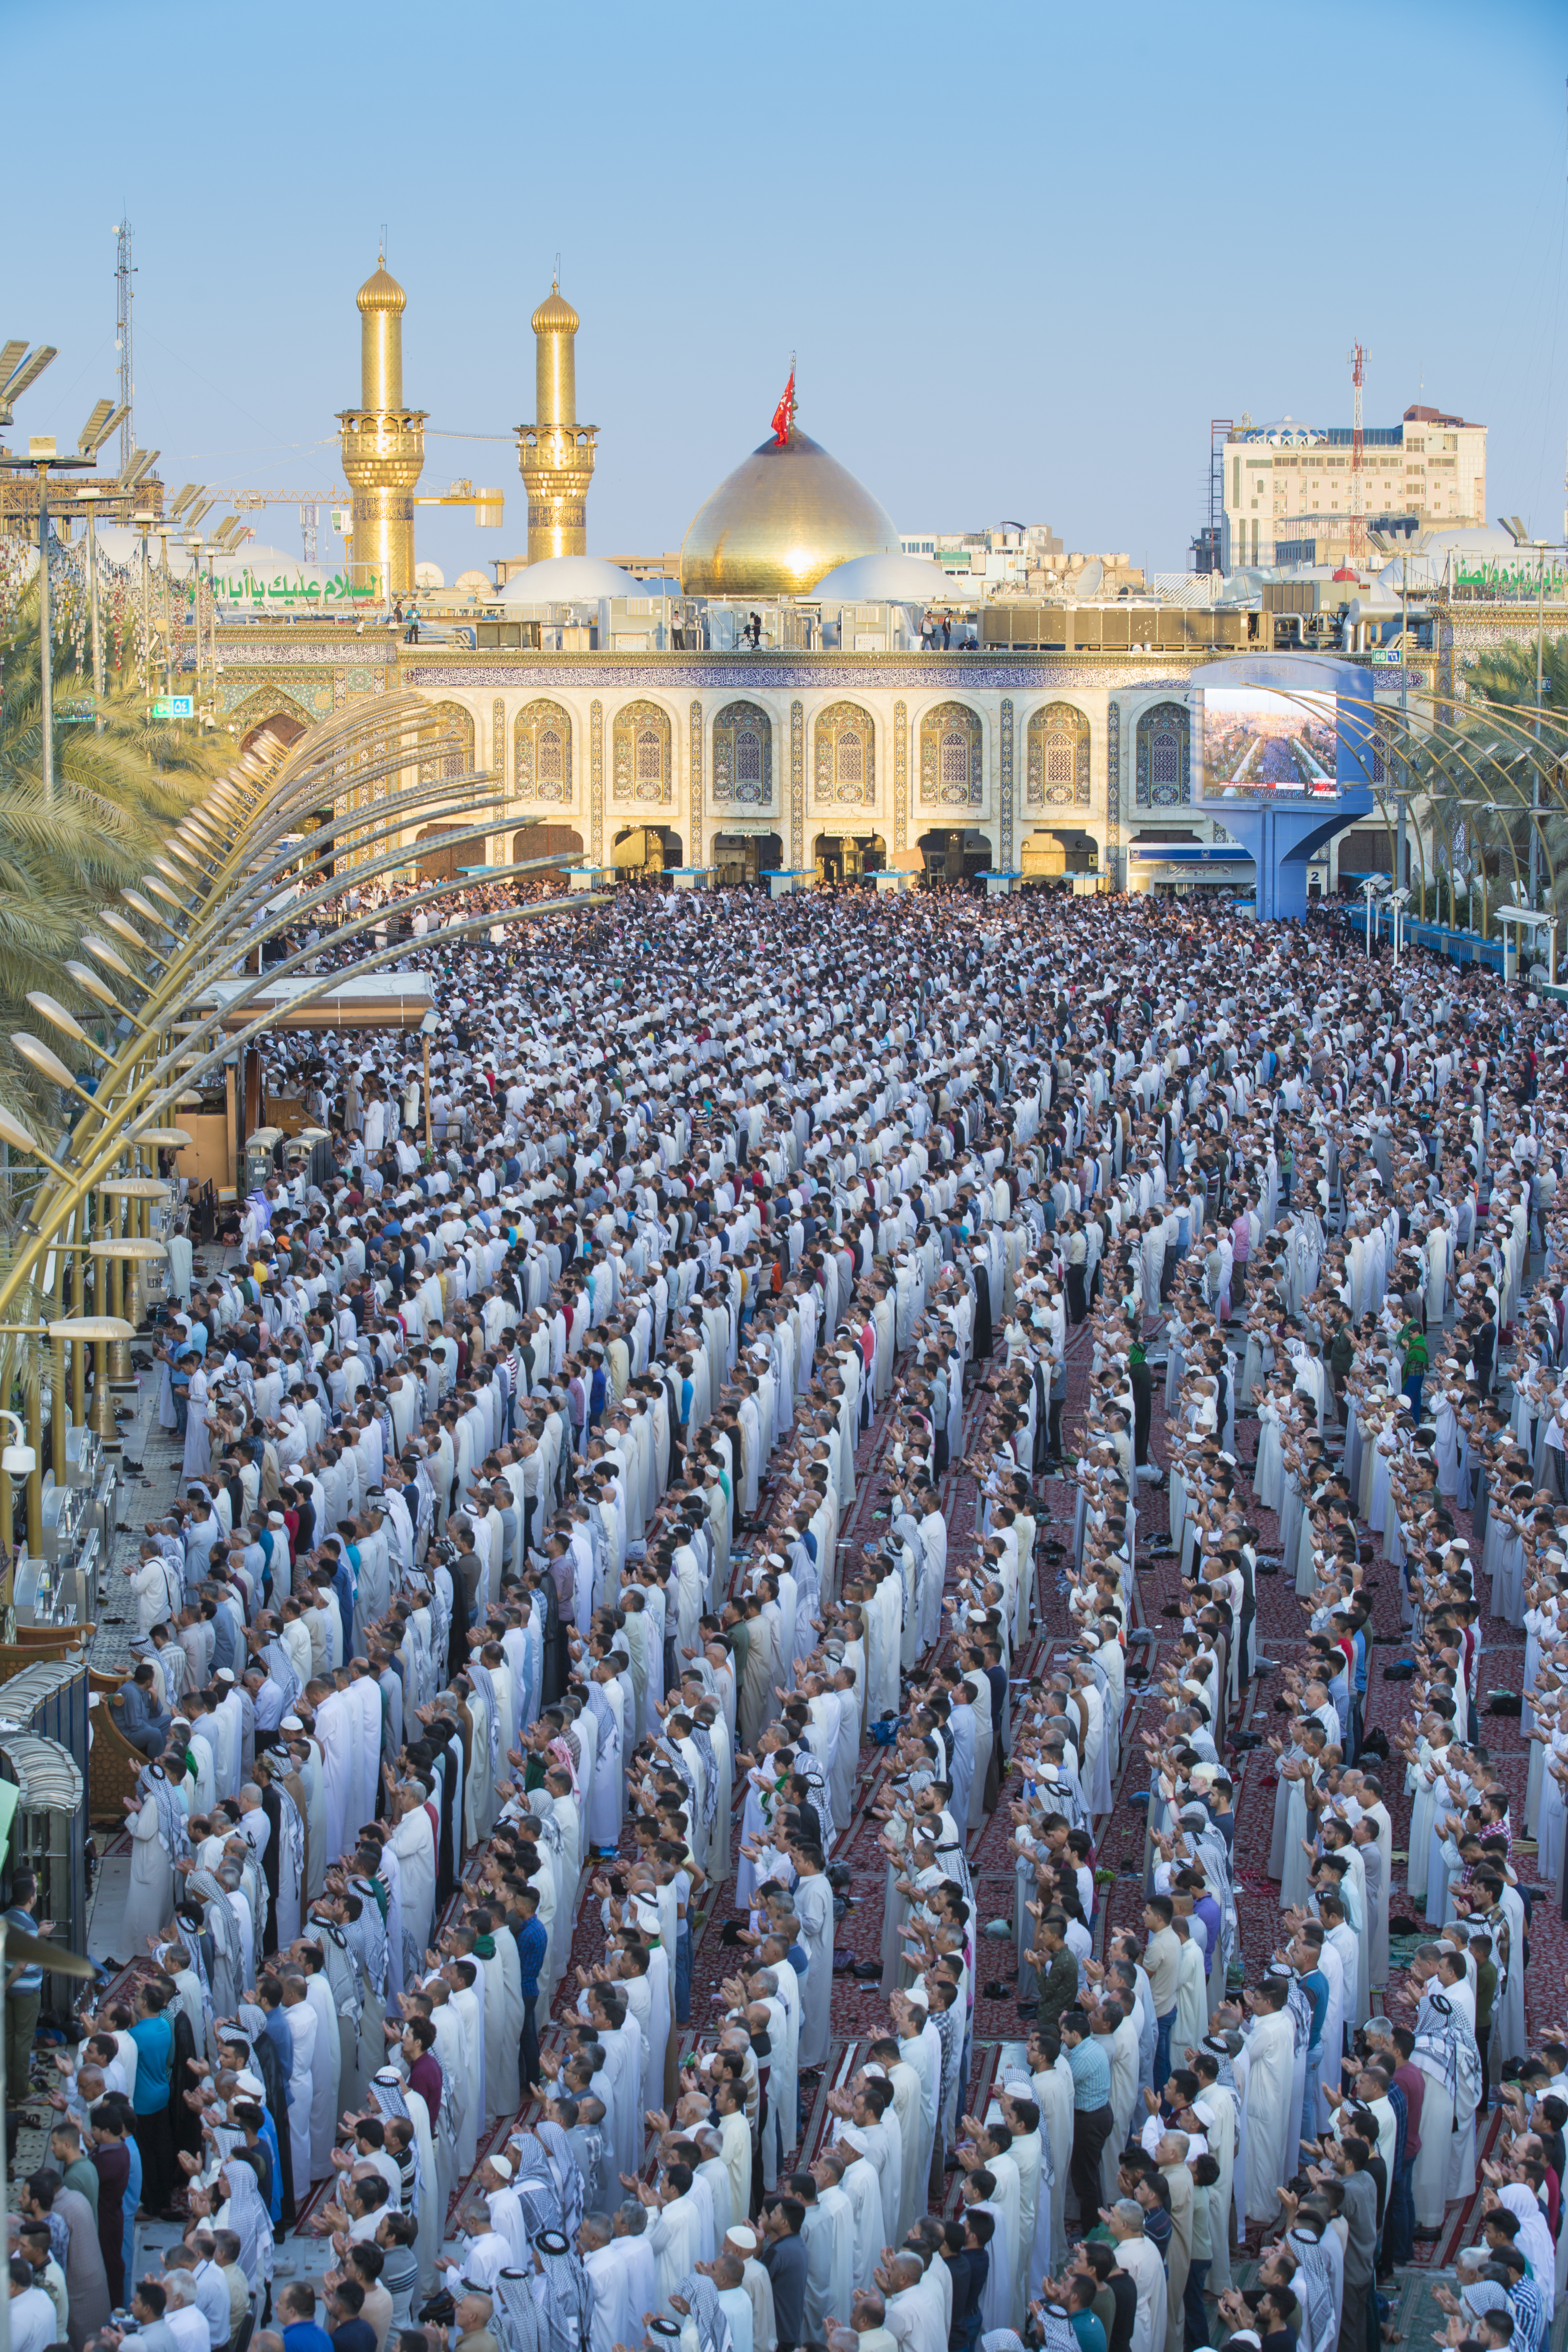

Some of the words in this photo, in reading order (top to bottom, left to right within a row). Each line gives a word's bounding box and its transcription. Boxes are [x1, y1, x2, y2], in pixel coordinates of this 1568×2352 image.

[1454, 559, 1499, 592] والصفا
[1500, 561, 1531, 592] زمزم
[267, 574, 321, 606] عليك
[324, 574, 383, 604] السلام
[1375, 652, 1385, 660] 66
[1388, 652, 1398, 661] ٦٦
[174, 700, 188, 713] ٥٤
[1311, 871, 1319, 882] 2
